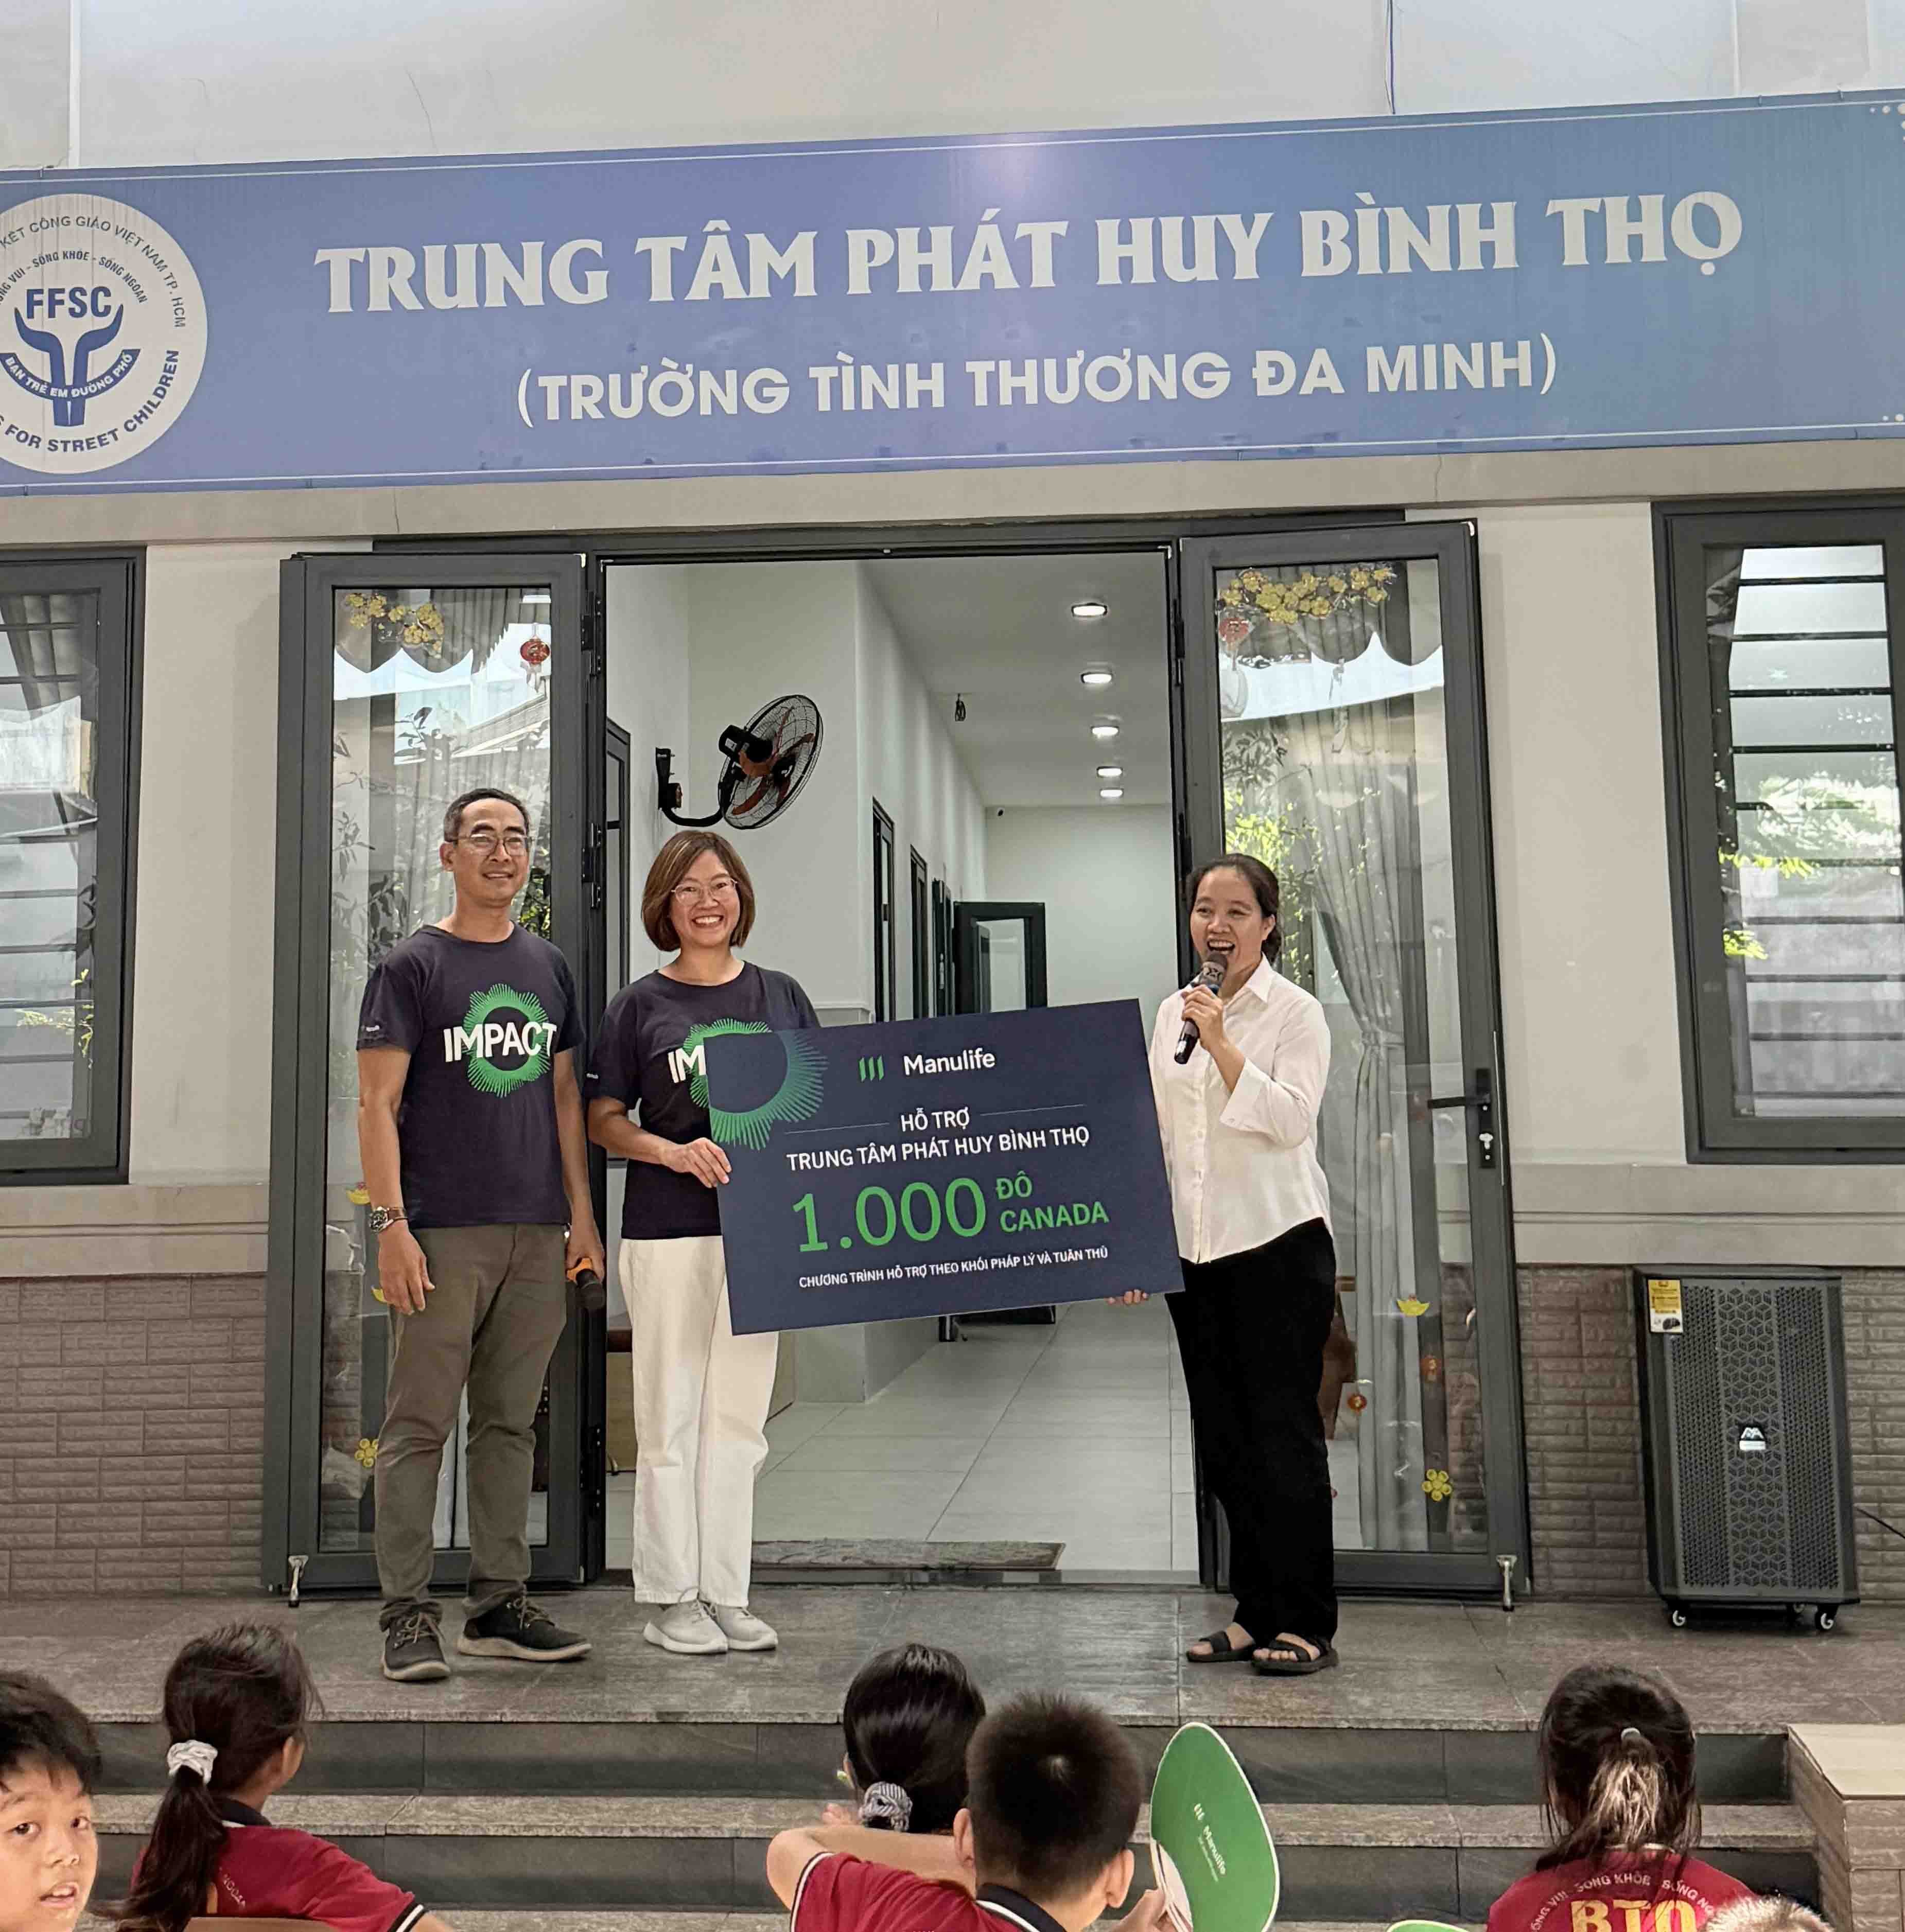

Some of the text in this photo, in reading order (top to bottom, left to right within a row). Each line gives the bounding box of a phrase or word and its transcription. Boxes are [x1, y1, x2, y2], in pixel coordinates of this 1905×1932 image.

[313, 191, 1742, 313] TRUNG TÂM PHÁT HUY BÌNH THỌ
[8, 268, 26, 283] VUI
[122, 273, 148, 303] NGOAN
[29, 216, 71, 233] CÔNG
[76, 216, 111, 231] GIÁO
[141, 244, 168, 272] NAM
[171, 297, 186, 327] HCM
[26, 286, 112, 319] FFSC
[50, 388, 68, 398] EM
[517, 333, 1556, 428] (TRƯỜNG TÌNH THƯƠNG ĐA MINH)
[5, 349, 180, 452] FOR STREET CHILDREN
[443, 1021, 557, 1063] IMPACT
[903, 1047, 995, 1076] Manulife
[901, 1106, 970, 1132] HỖ TRỢ
[786, 1126, 1089, 1171] TRUNG TÂM PHÁT HUY BÌNH THỌ
[995, 1170, 1033, 1200] ĐÔ
[792, 1178, 986, 1252] 1.000
[1000, 1201, 1110, 1233] CANADA
[799, 1273, 848, 1288] CHƯƠNG
[849, 1269, 884, 1283] TRÌNH
[905, 1264, 927, 1278] TRỢ
[929, 1262, 959, 1275] THEO
[991, 1254, 1021, 1269] PHÁP
[1023, 1252, 1036, 1267] LÝ
[1037, 1251, 1052, 1264] VÀ
